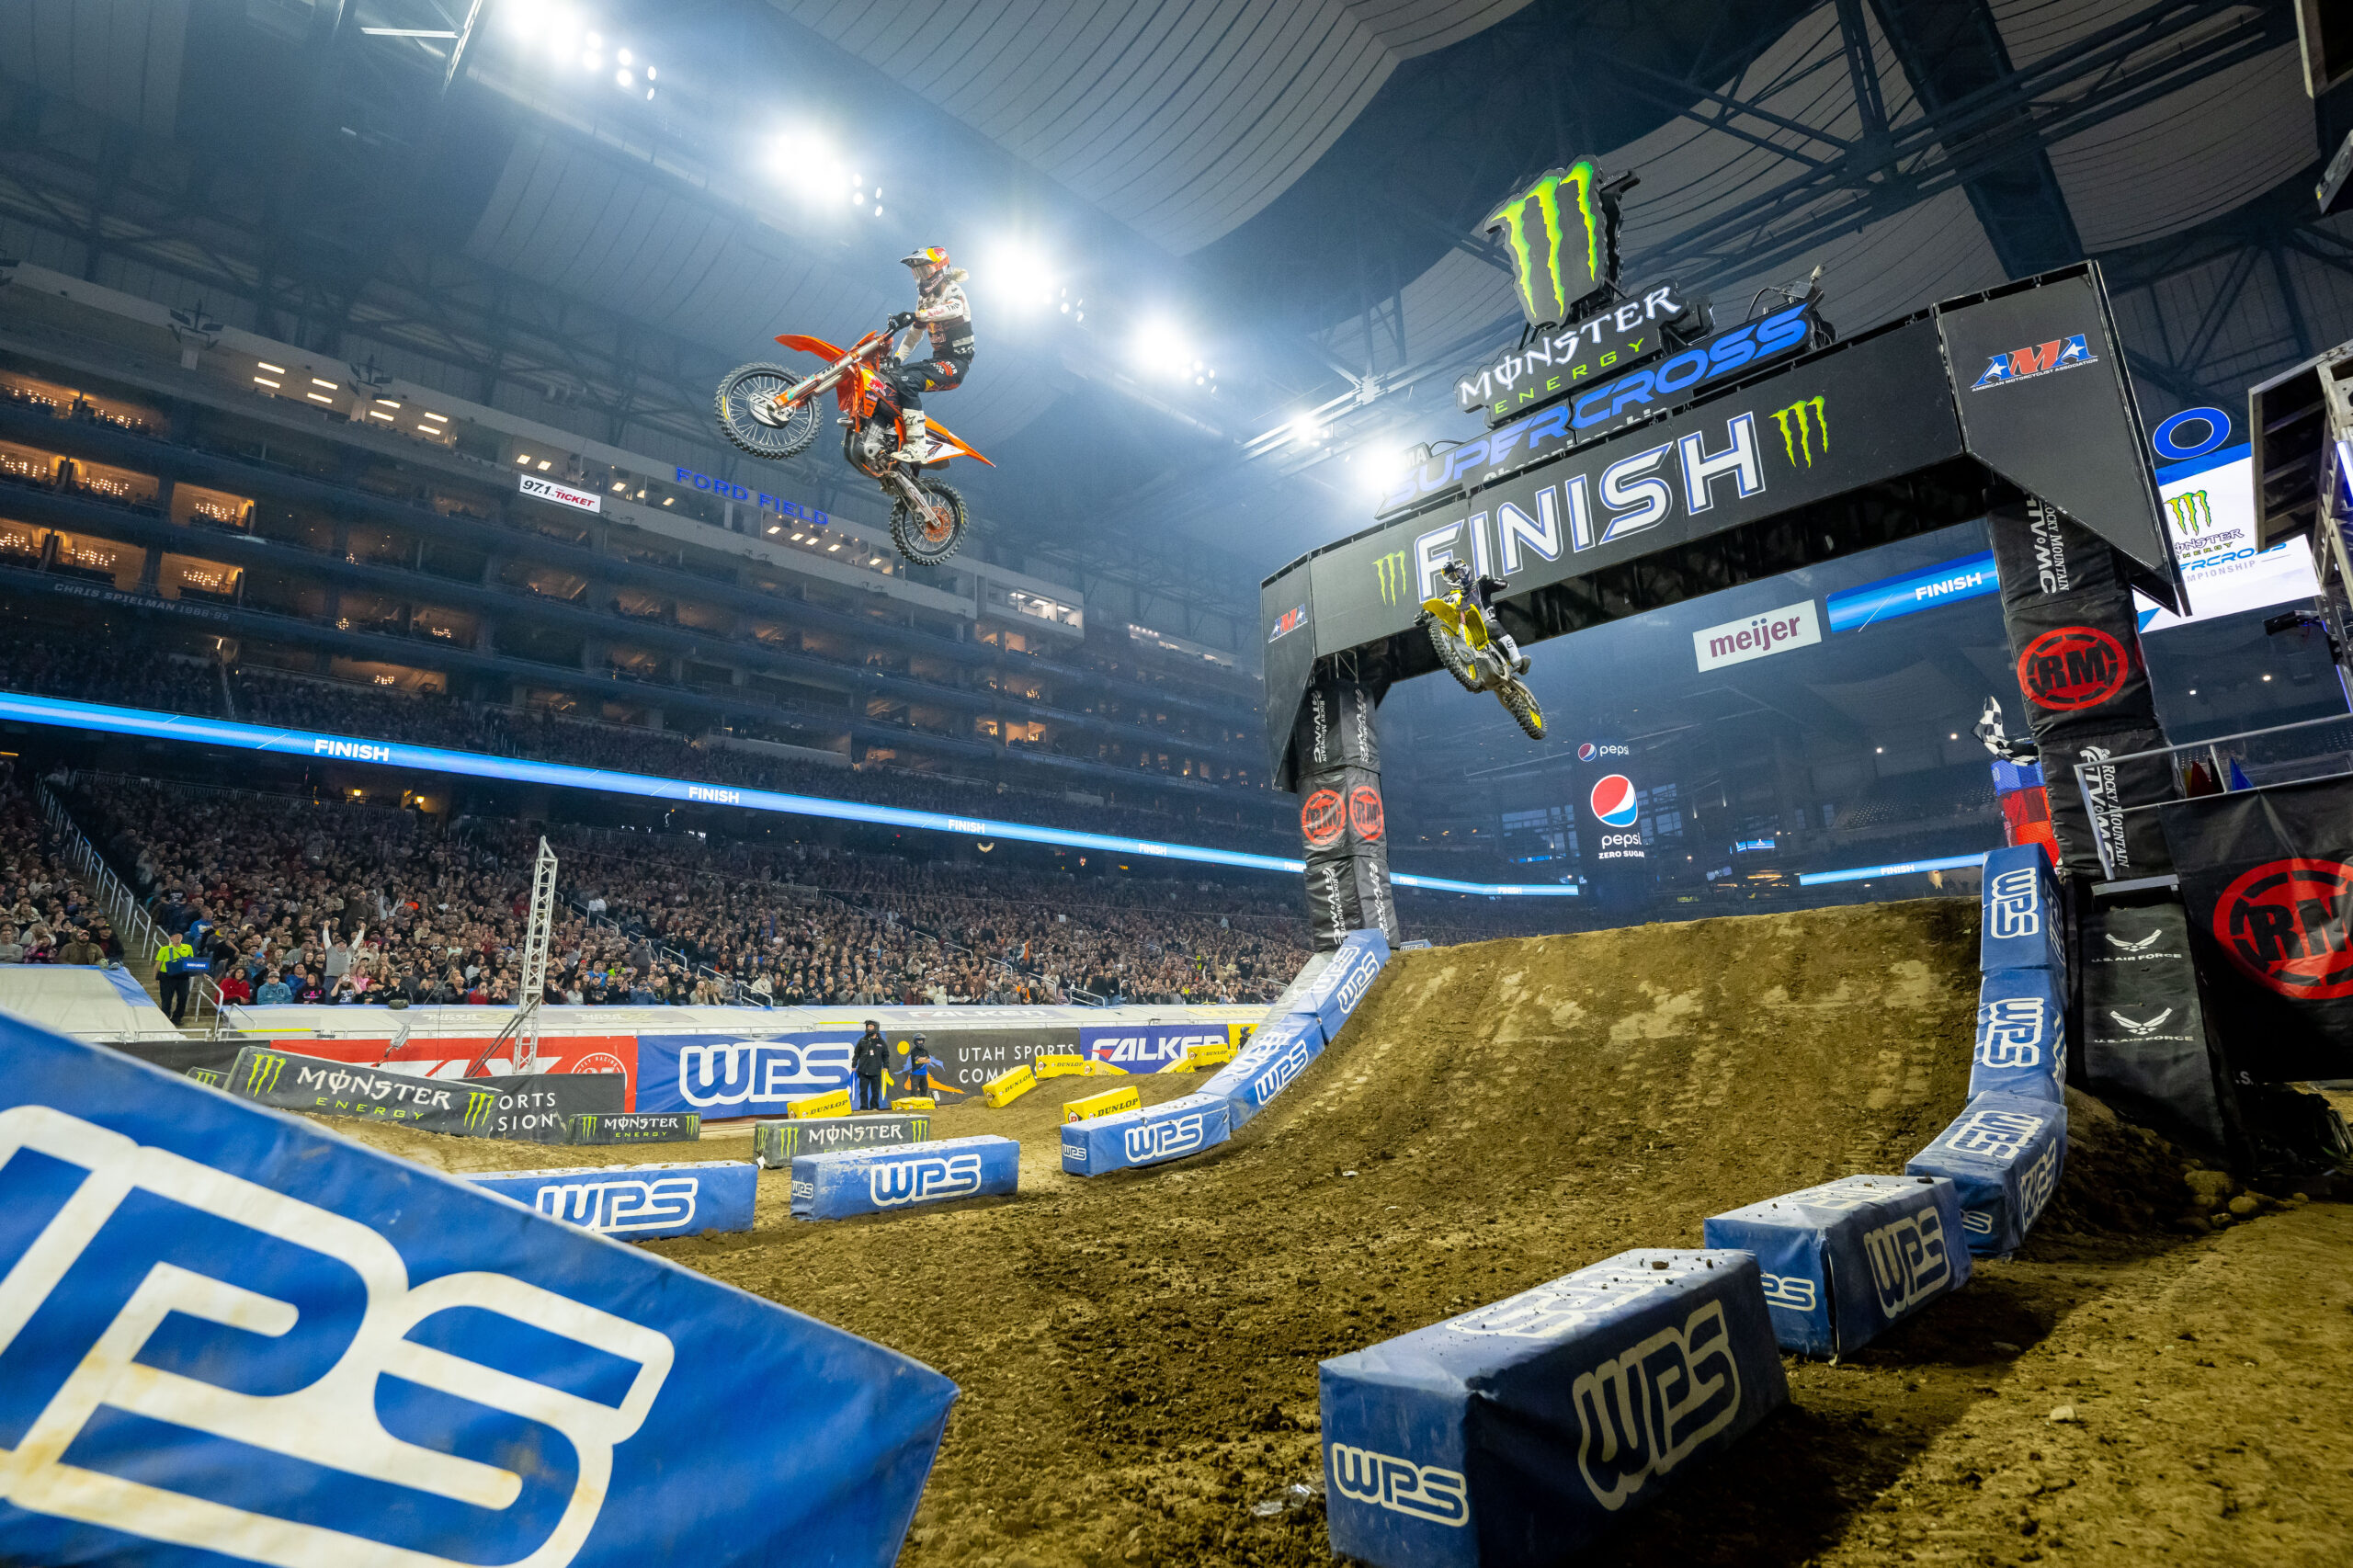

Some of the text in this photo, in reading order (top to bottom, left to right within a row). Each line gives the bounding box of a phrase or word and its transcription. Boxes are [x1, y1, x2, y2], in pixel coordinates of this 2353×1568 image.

[1495, 338, 1644, 415] ENERGY
[1971, 334, 2098, 388] AMA
[1972, 358, 2098, 392] AMERICAN MOTORCYCLIST ASSOCIATION
[1379, 302, 1810, 509] SUPERCROSS
[522, 480, 551, 495] 97.1
[555, 490, 595, 506] TICKET
[676, 467, 828, 525] FORD FIELD
[1413, 411, 1766, 604] FINISH
[2044, 505, 2070, 591] OCKY MOUNTAIN
[54, 583, 100, 597] CHRIS
[103, 592, 176, 611] SPIELMAN
[1915, 573, 1983, 601] FINISH
[1268, 603, 1308, 641] AMA
[1709, 614, 1801, 659] meijer
[2037, 652, 2107, 688] RM
[313, 738, 390, 763] FINISH
[1599, 744, 1630, 756] pepsi
[688, 786, 740, 804] FINISH
[948, 819, 985, 834] FINISH
[2101, 764, 2131, 868] ROCKY MOUNTAIN
[1138, 843, 1167, 856] FINISH
[1598, 850, 1645, 859] ZERO SUGAR
[1601, 832, 1643, 848] pepsi
[1880, 864, 1915, 875] FINISH
[1332, 878, 1340, 902] ROCKY
[1497, 886, 1522, 894] FINISH
[1990, 867, 2040, 939] WPS
[2138, 952, 2182, 960] FORCE
[1336, 950, 1381, 1015] WPS
[1982, 997, 2045, 1069] WPS
[959, 1044, 1074, 1062] UTAH SPORTS
[679, 1041, 855, 1108] WPS
[1005, 1073, 1032, 1093] DUNLOP
[1254, 1039, 1309, 1106] WPS
[315, 1096, 425, 1120] ENERGY
[810, 1099, 848, 1115] DUNLOP
[1097, 1097, 1139, 1117] DUNLOP
[1062, 1143, 1086, 1161] WPS
[1124, 1113, 1203, 1163] WPS
[791, 1180, 814, 1199] WPS
[870, 1153, 982, 1207] WPS
[536, 1177, 699, 1233] WPS
[1863, 1205, 1951, 1319] WPS
[1573, 1299, 1742, 1512] WPS
[1331, 1441, 1471, 1528] WPS
